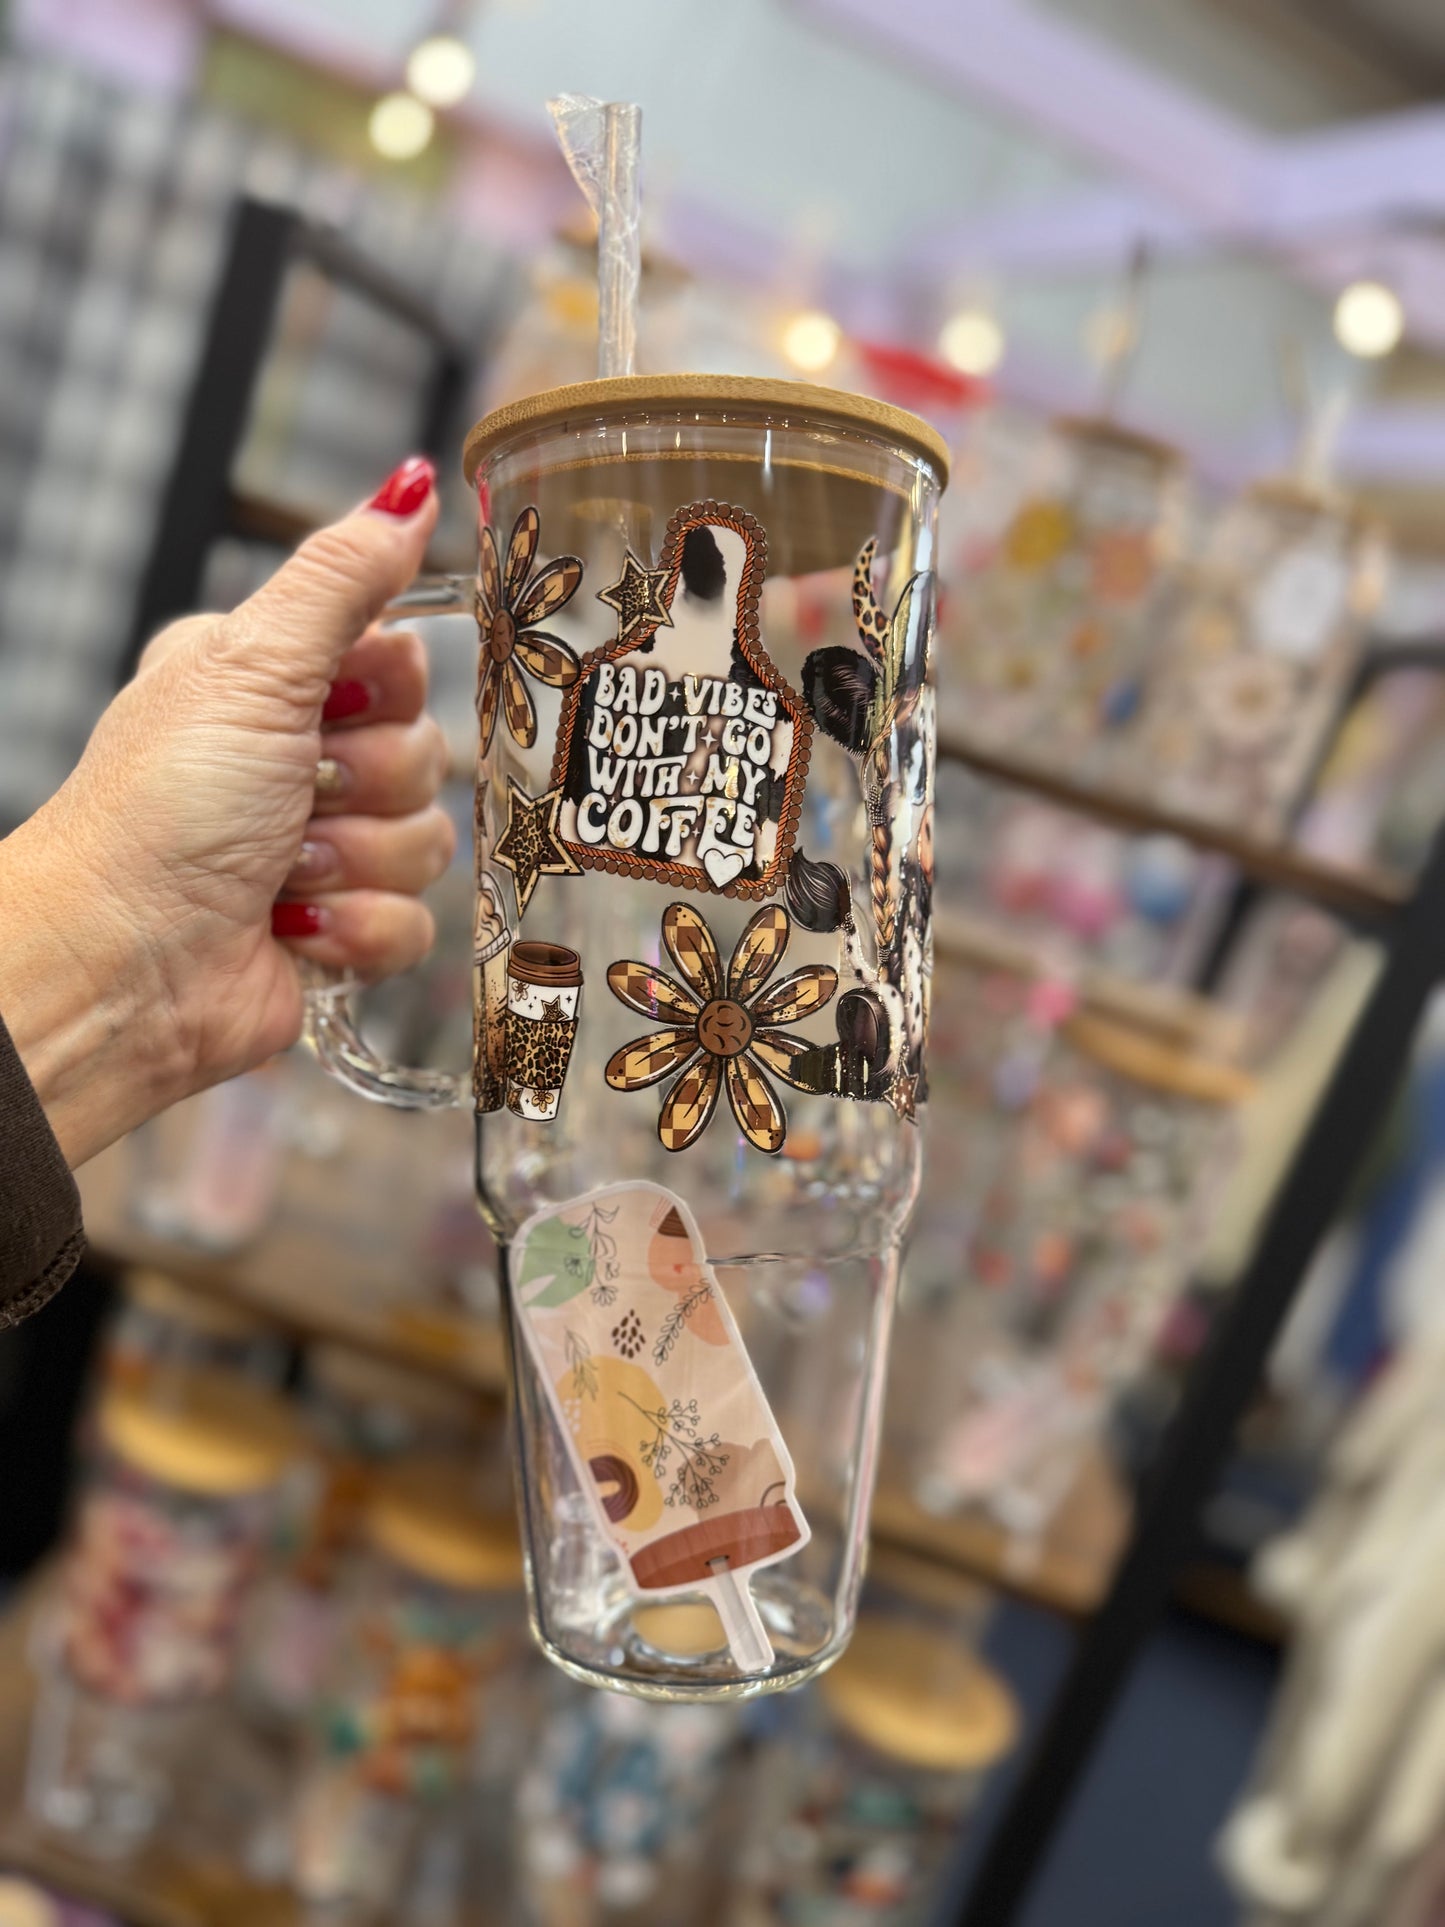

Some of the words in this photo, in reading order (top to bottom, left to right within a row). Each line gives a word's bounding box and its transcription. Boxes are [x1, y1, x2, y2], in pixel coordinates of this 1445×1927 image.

[594, 663, 666, 715] BAD
[683, 674, 778, 730] VIBES
[588, 705, 707, 758] DON'T
[721, 718, 771, 766] GO
[587, 745, 687, 798] WITH
[700, 754, 766, 805] MY
[577, 792, 757, 869] COFFEE
